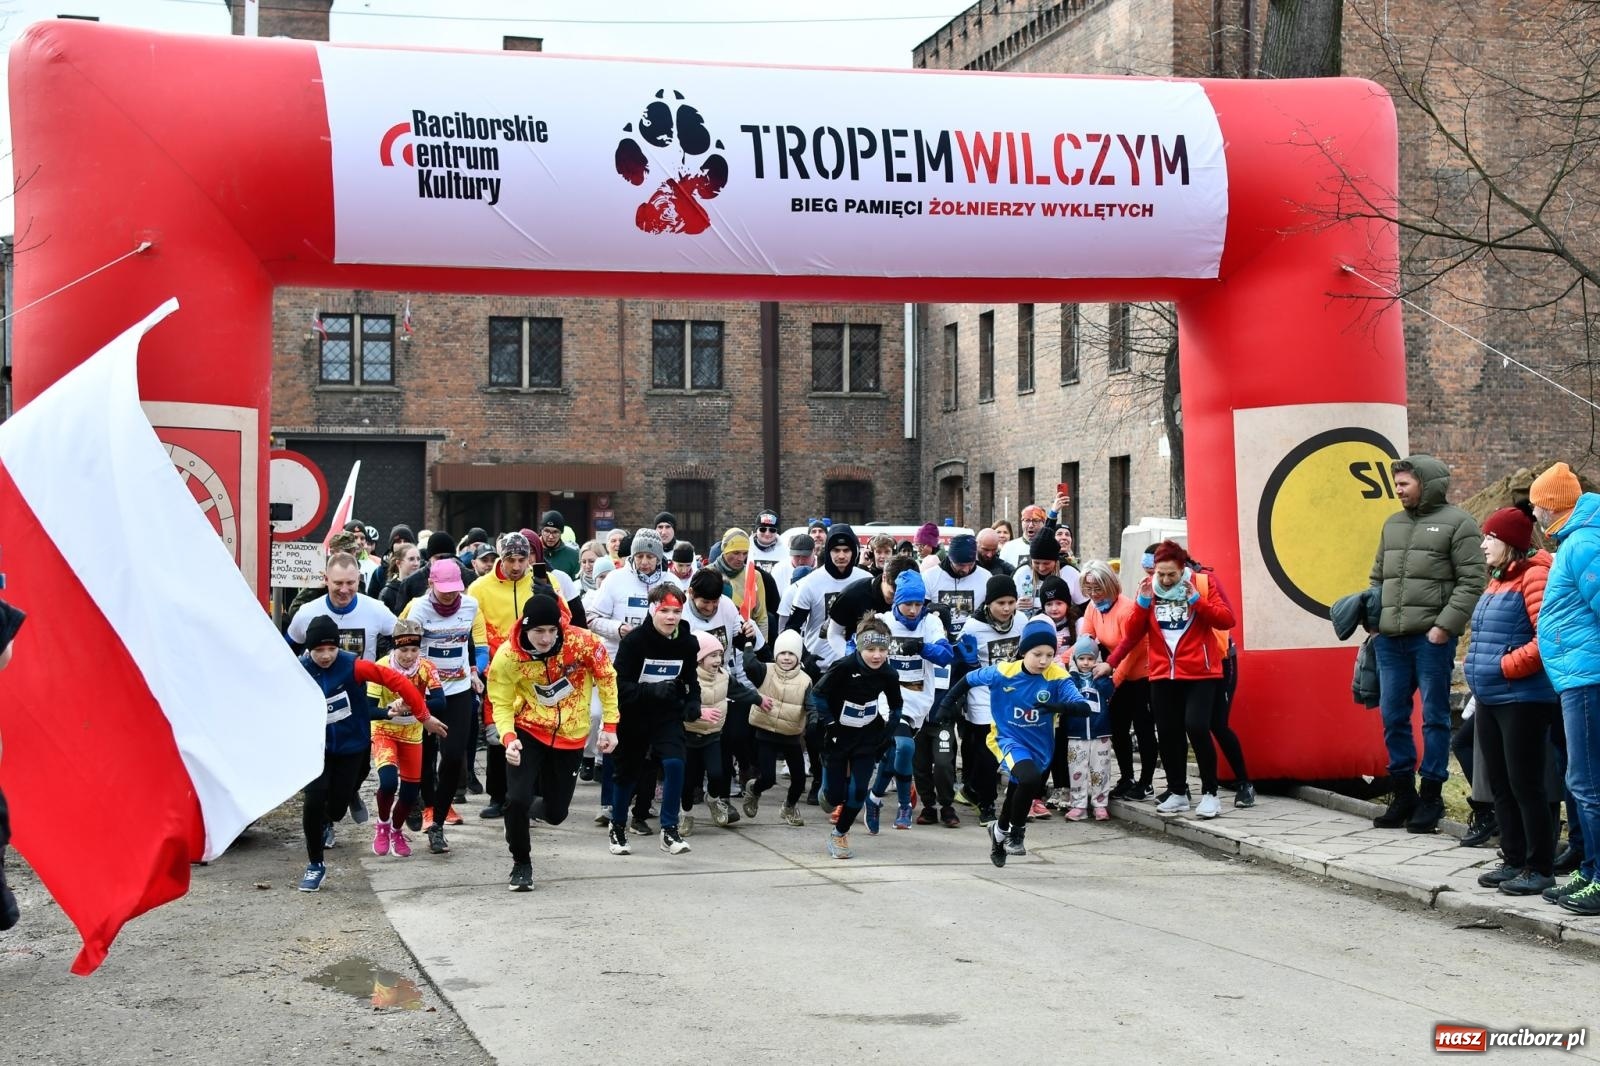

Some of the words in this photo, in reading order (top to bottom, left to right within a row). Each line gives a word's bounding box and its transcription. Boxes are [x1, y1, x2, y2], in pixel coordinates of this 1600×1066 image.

[412, 109, 549, 143] Raciborskie
[417, 169, 502, 206] Kultury
[791, 197, 838, 213] BIEG
[844, 198, 923, 219] PAMIĘCI
[928, 197, 1036, 217] ŻOŁNIERZY
[1041, 203, 1155, 221] WYKLĘTYCH
[285, 543, 318, 551] POJAZDÓW
[442, 649, 450, 657] 17
[901, 661, 910, 669] 75
[657, 666, 667, 674] 44
